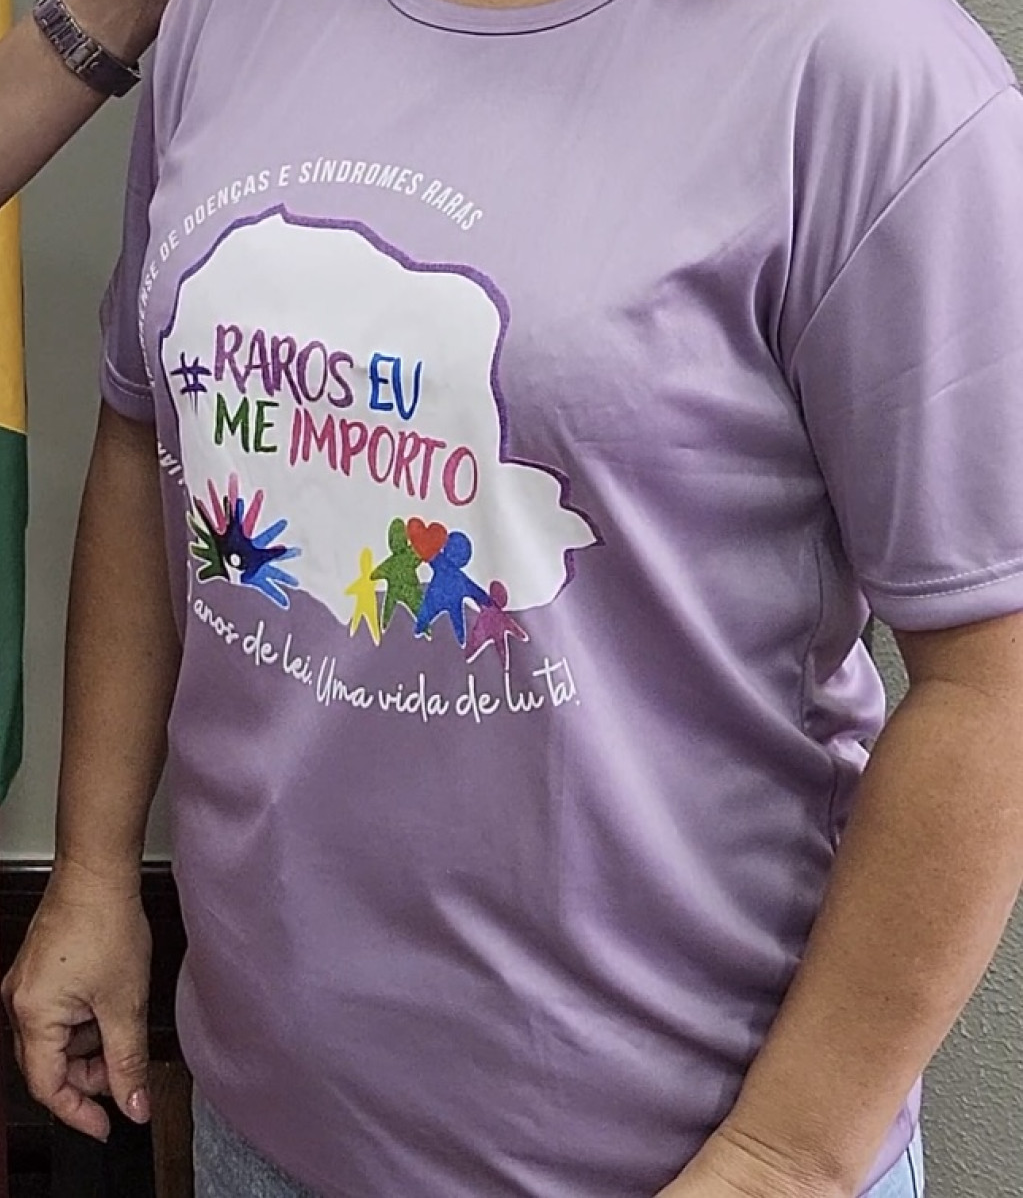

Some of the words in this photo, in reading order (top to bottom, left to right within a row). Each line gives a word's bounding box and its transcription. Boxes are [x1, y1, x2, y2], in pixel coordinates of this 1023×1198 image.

[159, 229, 179, 262] DE
[183, 169, 270, 234] DOENÇAS
[278, 164, 291, 187] E
[298, 156, 423, 196] SÍNDROMES
[421, 179, 484, 232] RARAS
[368, 352, 422, 420] EU
[213, 391, 278, 453] ME
[289, 409, 478, 506] IMPORTO
[193, 600, 237, 645] anos
[243, 620, 278, 667] de
[316, 655, 374, 707] Uma
[378, 672, 450, 723] vida
[456, 674, 500, 723] de
